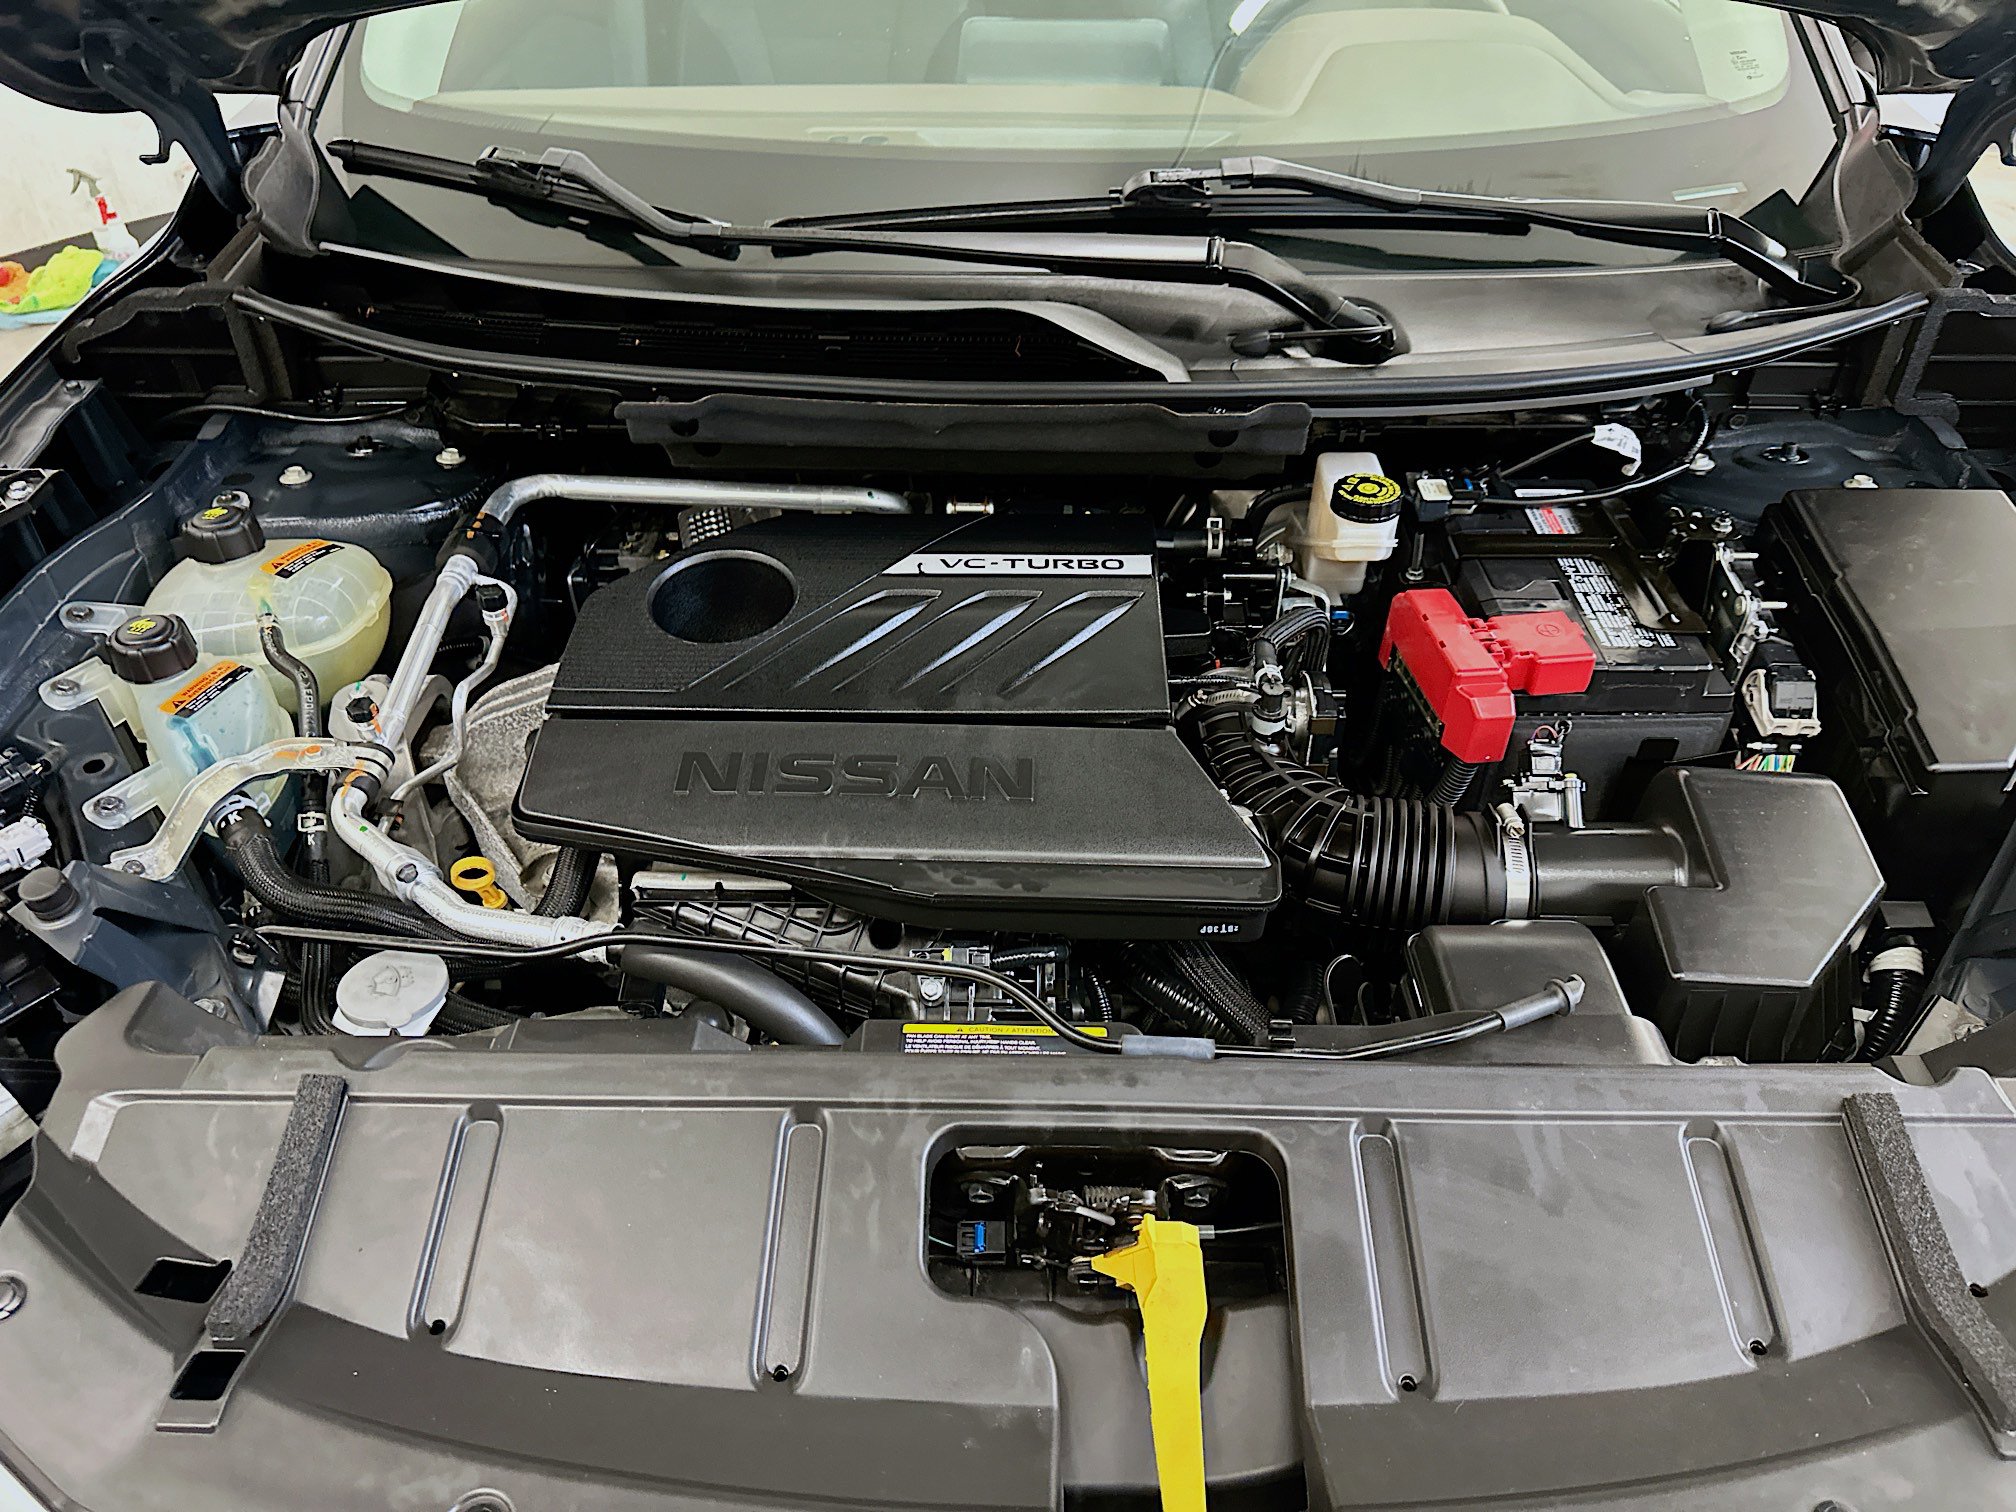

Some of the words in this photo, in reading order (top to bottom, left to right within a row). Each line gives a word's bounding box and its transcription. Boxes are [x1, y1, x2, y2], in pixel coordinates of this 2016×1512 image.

[939, 558, 1125, 570] VC-TURBO
[673, 751, 1035, 802] NISSAN
[227, 810, 243, 826] K
[306, 833, 316, 846] K
